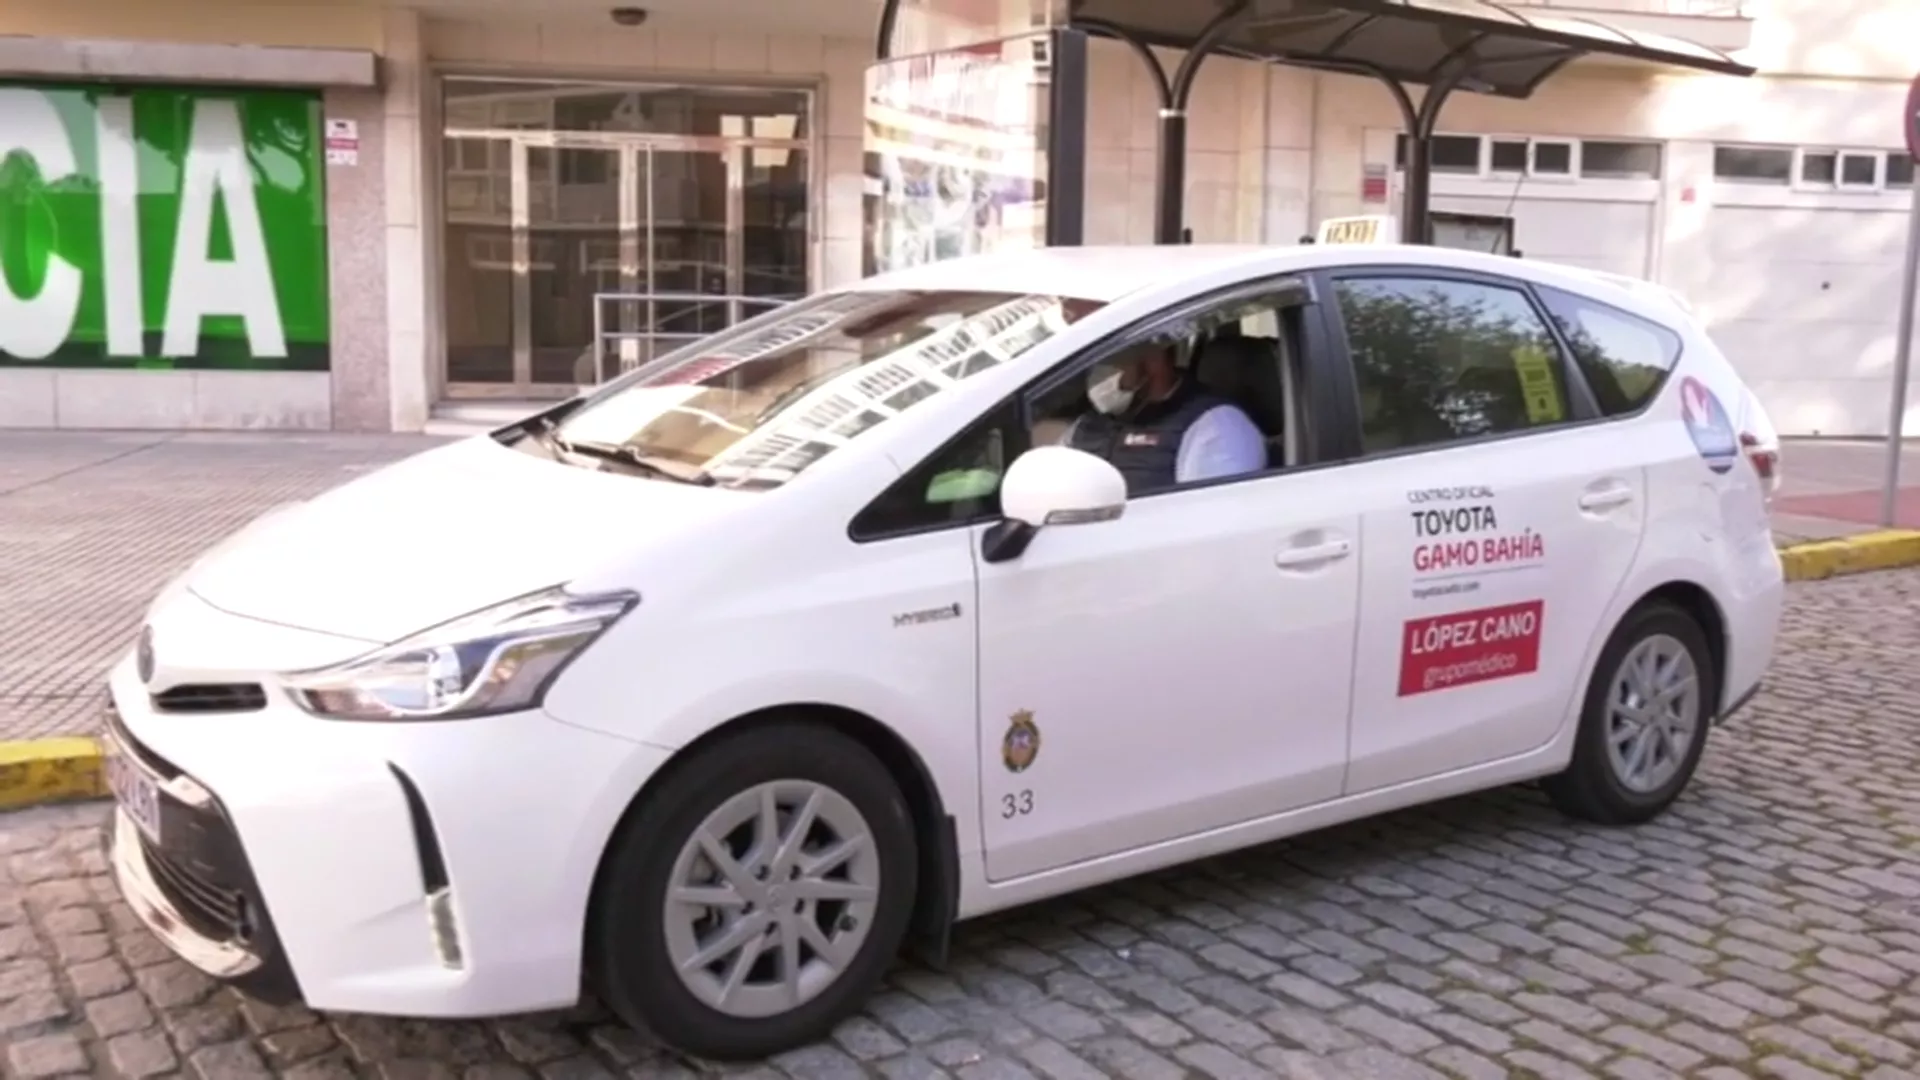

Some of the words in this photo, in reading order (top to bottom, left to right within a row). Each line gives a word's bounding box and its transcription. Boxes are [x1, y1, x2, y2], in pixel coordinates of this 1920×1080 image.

[0, 87, 288, 360] CIA
[1406, 487, 1451, 504] CENTRO
[1453, 485, 1495, 501] OFICIAL
[1411, 505, 1497, 537] TOYOTA
[1413, 540, 1480, 572] GAMO
[1483, 526, 1545, 564] BAHÍA
[1411, 620, 1479, 655] LÓPEZ
[1481, 611, 1536, 643] CANO
[1001, 788, 1035, 820] 33
